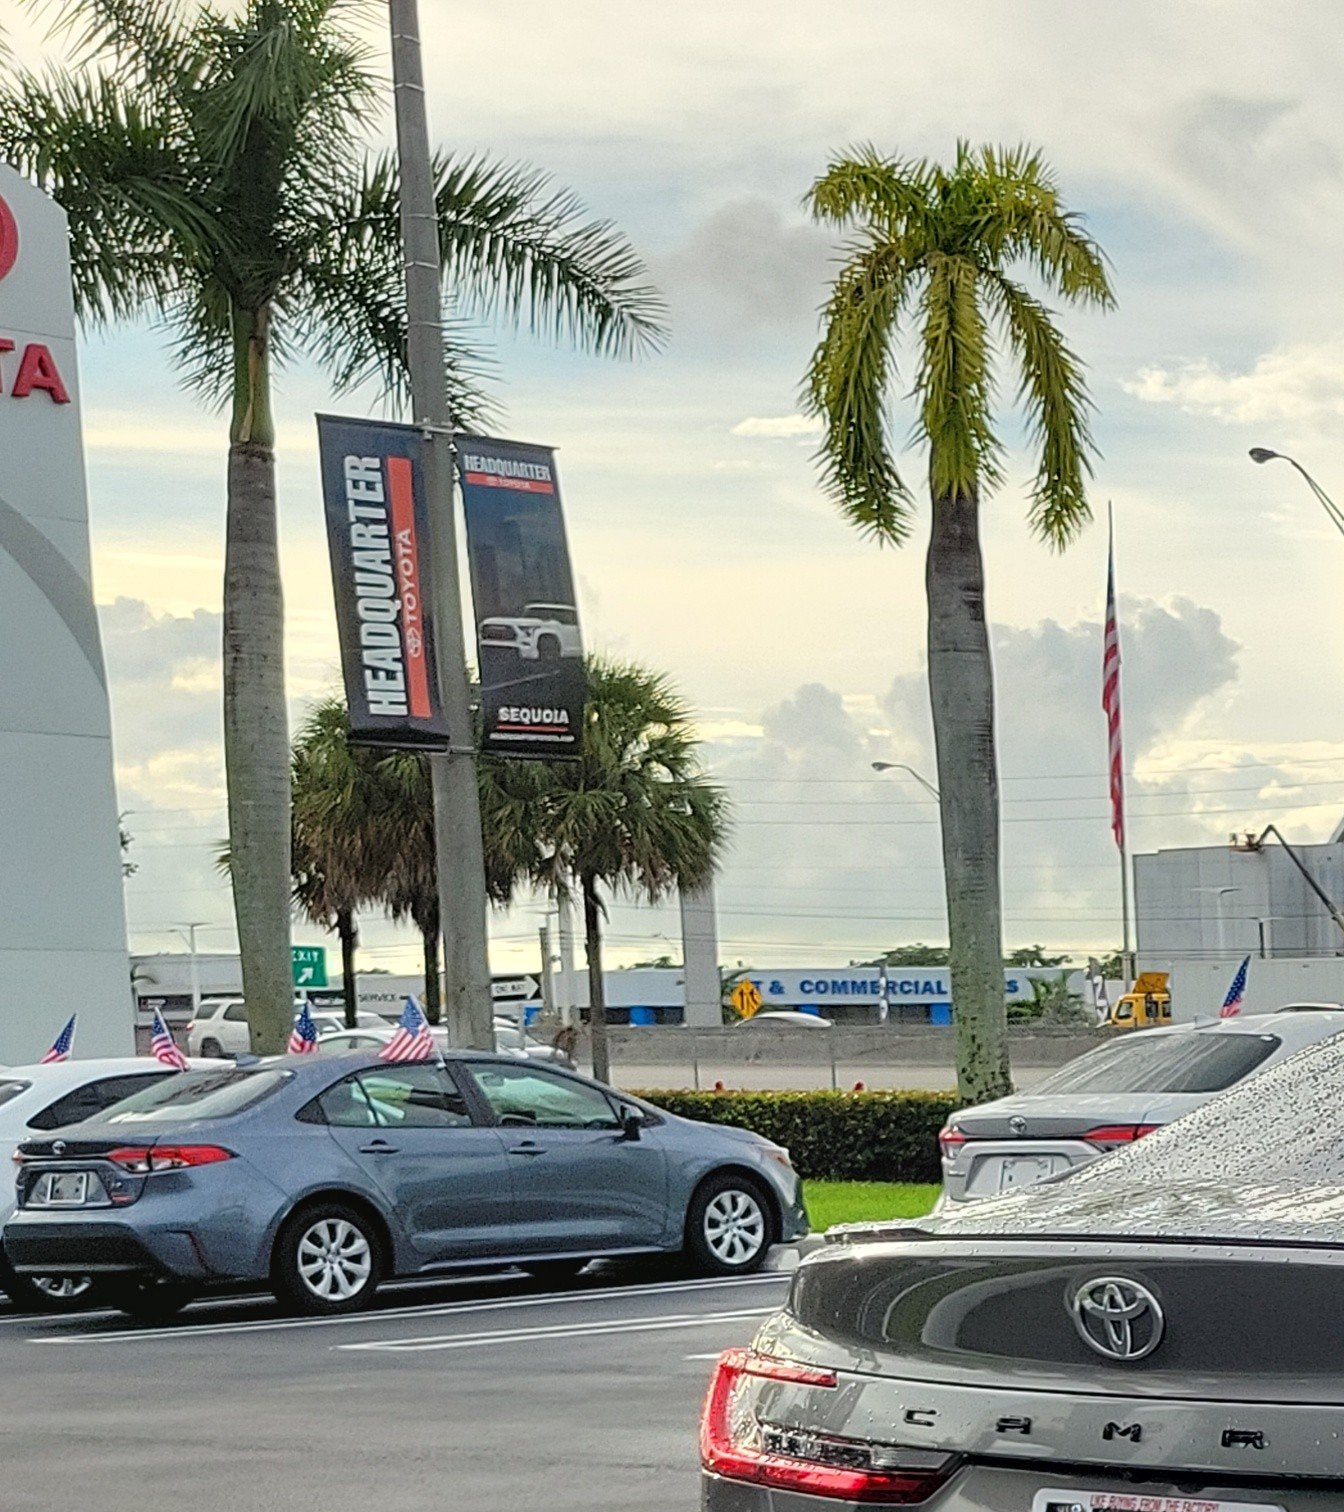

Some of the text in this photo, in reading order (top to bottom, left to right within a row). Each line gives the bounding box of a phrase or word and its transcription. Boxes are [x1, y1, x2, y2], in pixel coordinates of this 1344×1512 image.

[464, 455, 551, 481] HEADQUARTER
[344, 455, 408, 716] HEADQUARTER
[397, 529, 419, 623] TOYOTA
[498, 707, 570, 724] SEQUOIA
[769, 980, 785, 995] &
[800, 980, 948, 995] COMMERCIAL
